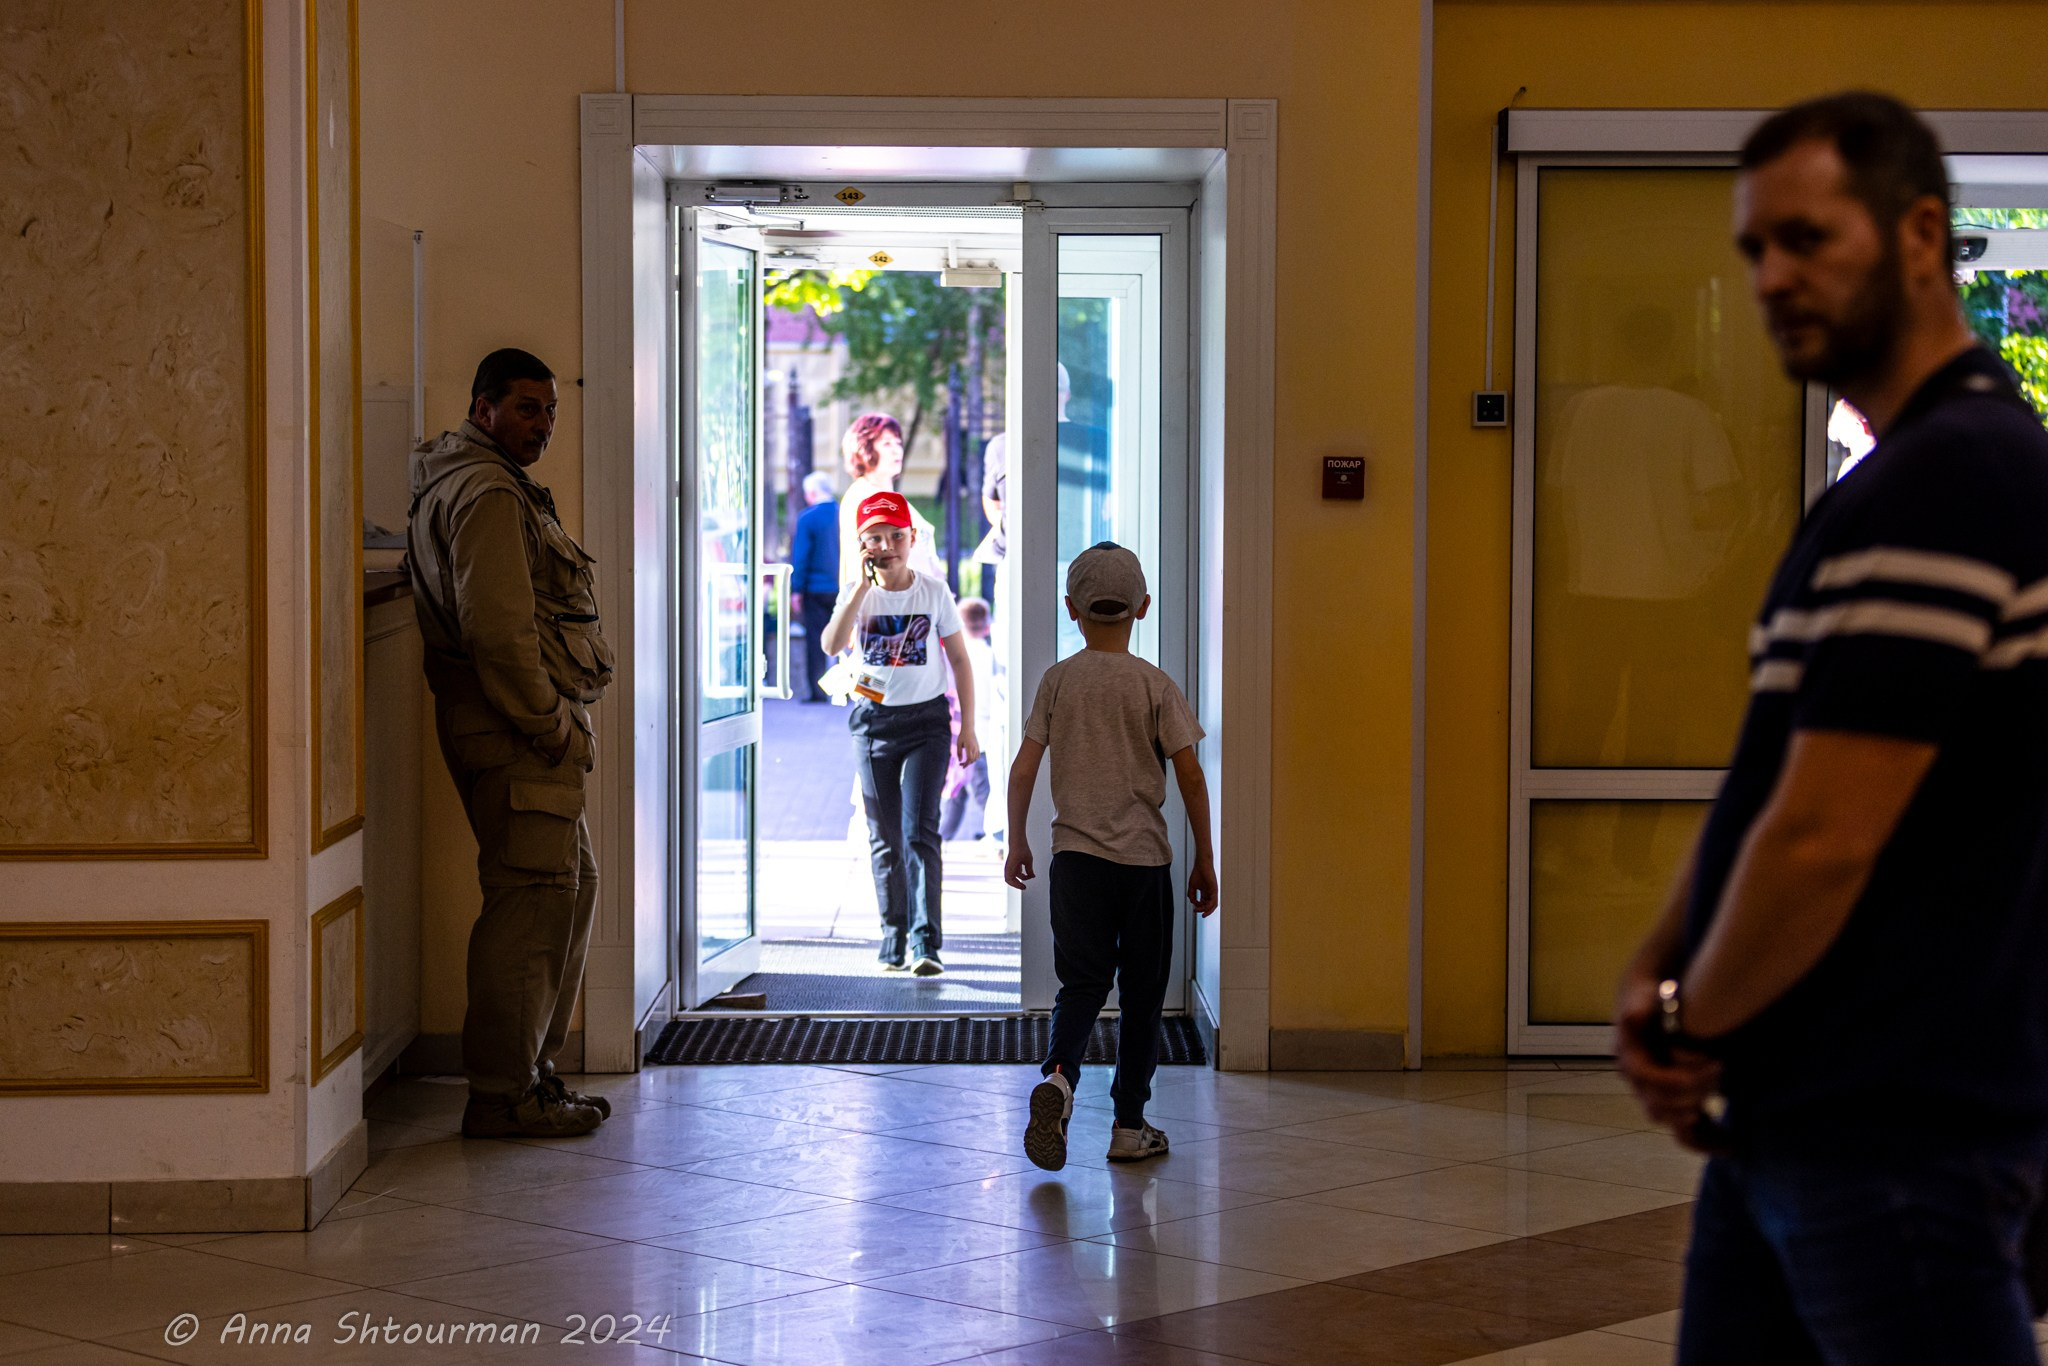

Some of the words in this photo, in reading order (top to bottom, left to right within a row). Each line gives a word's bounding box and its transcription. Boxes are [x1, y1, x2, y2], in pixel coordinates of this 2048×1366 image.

[841, 192, 859, 200] 143
[874, 255, 888, 263] 142
[1327, 460, 1361, 468] ПОЖАР
